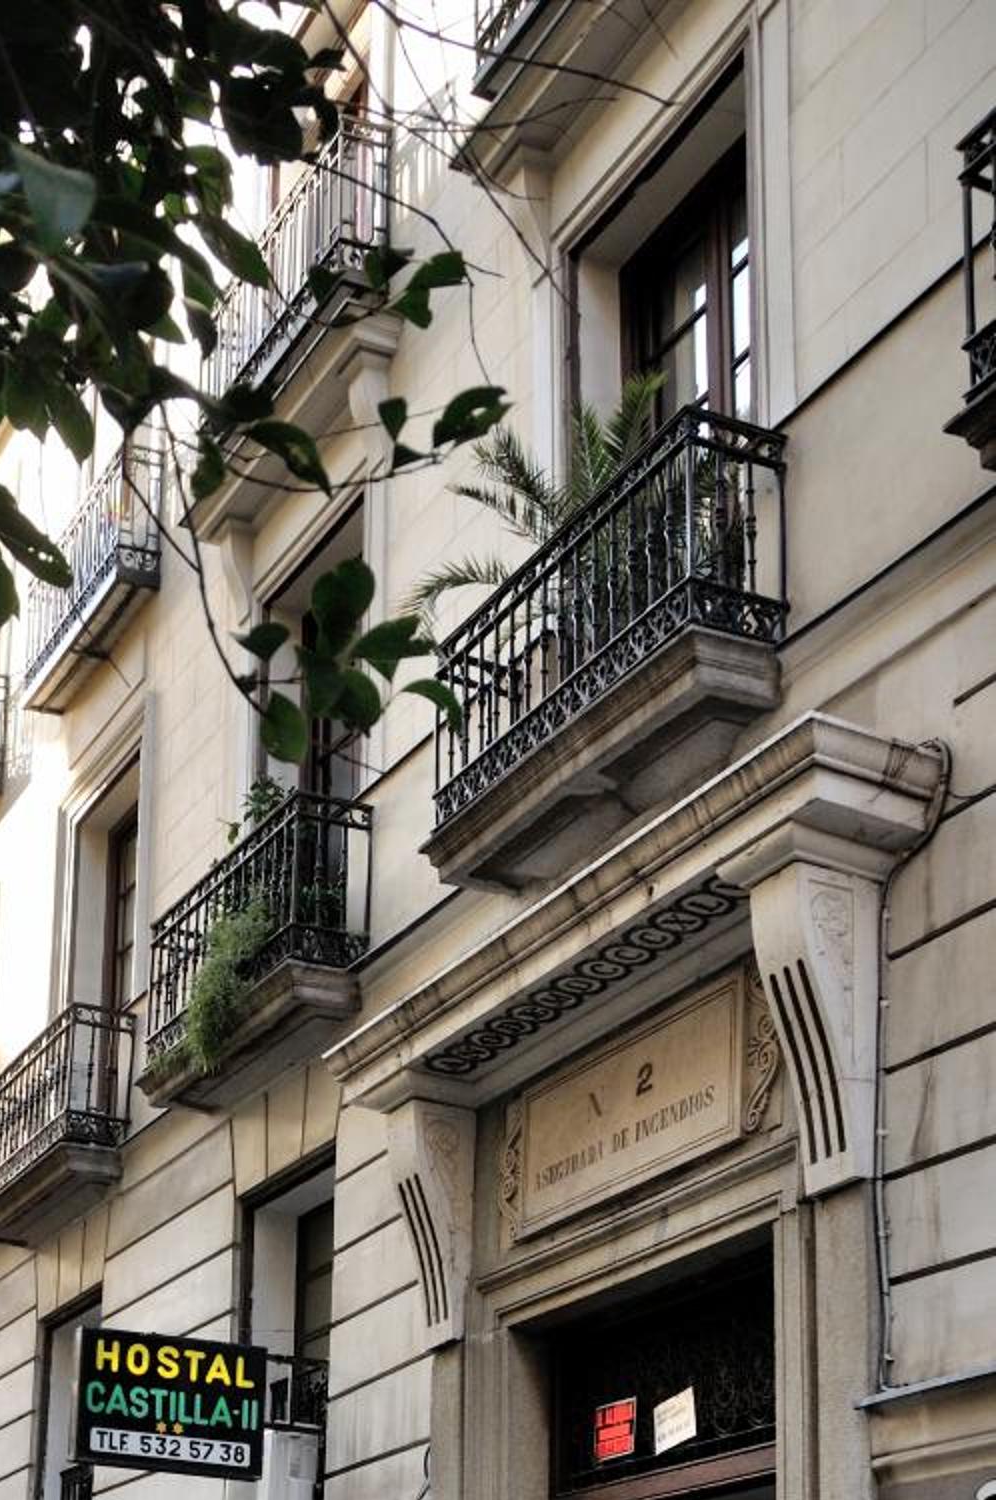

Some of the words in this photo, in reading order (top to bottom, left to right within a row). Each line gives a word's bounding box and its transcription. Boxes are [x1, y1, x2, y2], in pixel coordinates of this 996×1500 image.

[635, 1061, 654, 1097] 2
[612, 1127, 630, 1153] DE
[635, 1084, 715, 1143] INCENDIOS
[95, 1338, 255, 1388] HOSTAL
[139, 1435, 181, 1457] 532
[189, 1440, 213, 1460] 57
[219, 1443, 245, 1464] 38
